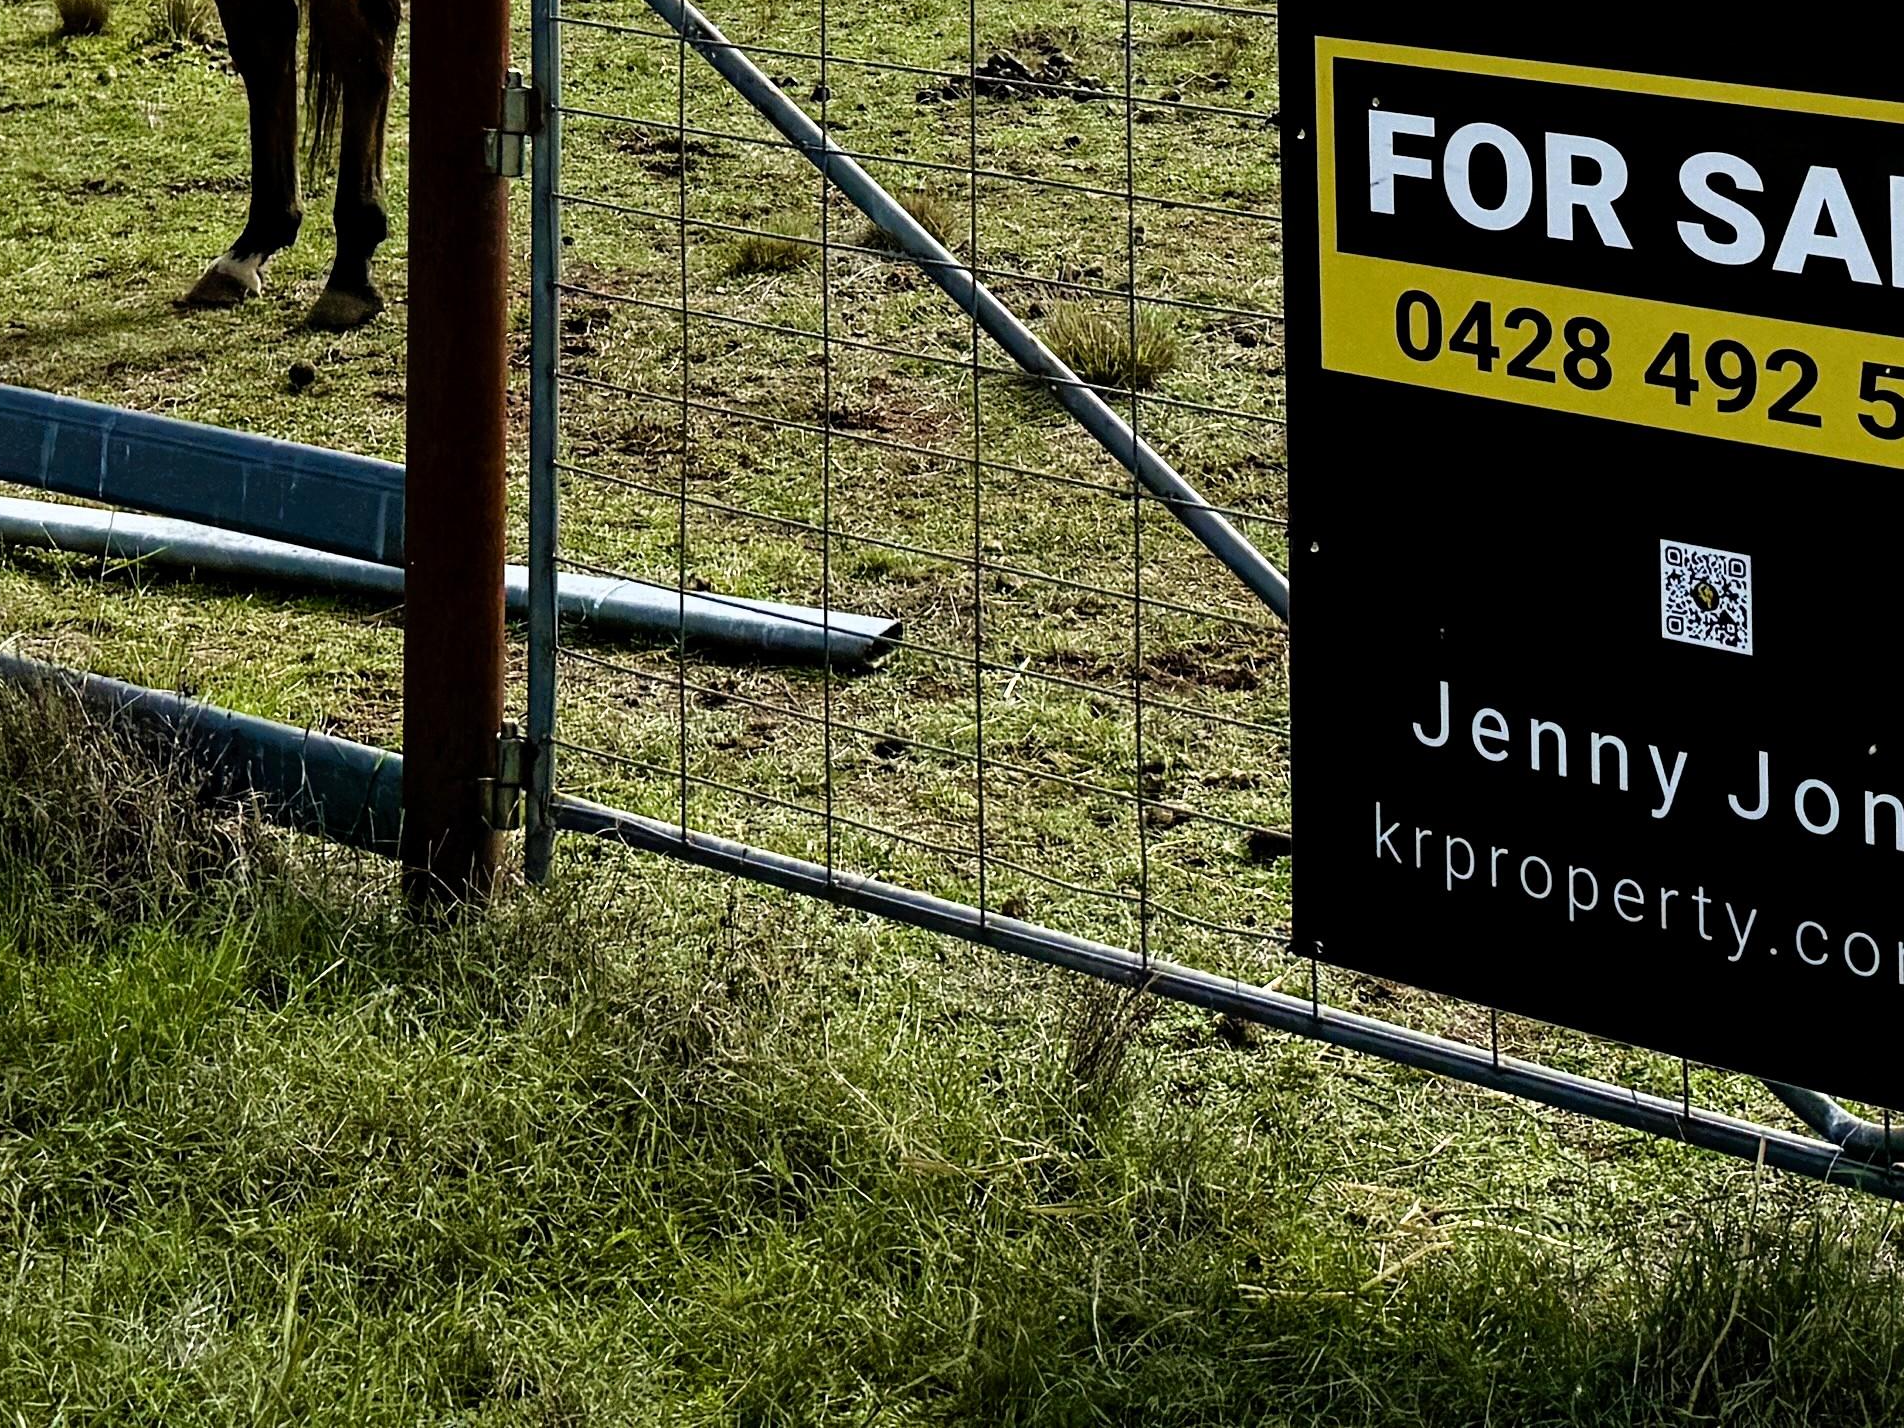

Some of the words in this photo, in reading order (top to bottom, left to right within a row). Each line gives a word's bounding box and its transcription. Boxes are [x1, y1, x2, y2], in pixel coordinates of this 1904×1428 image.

[1368, 109, 1633, 249] FOR
[1395, 290, 1613, 391] 0428
[1645, 332, 1822, 428] 492
[1412, 681, 1688, 819] Jenny
